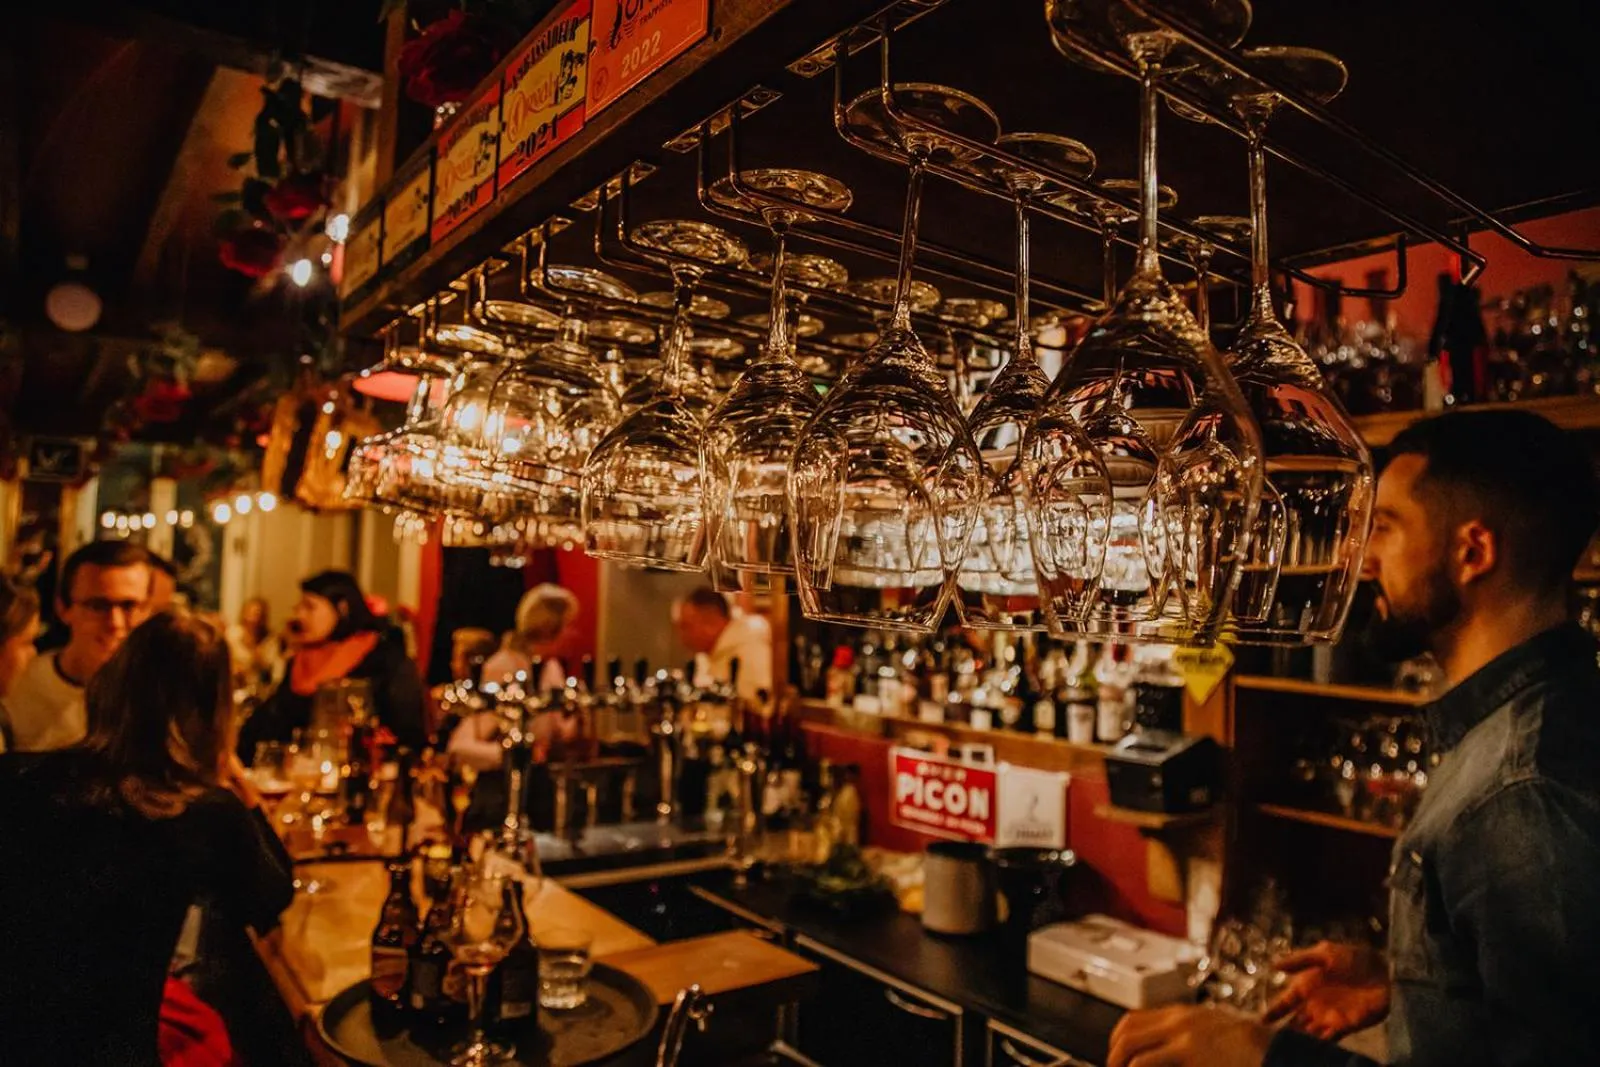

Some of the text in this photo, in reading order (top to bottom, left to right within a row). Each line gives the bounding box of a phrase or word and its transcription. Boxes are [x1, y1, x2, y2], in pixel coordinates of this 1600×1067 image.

[620, 30, 661, 79] 2022
[514, 112, 558, 166] 2021
[895, 769, 990, 822] PICON
